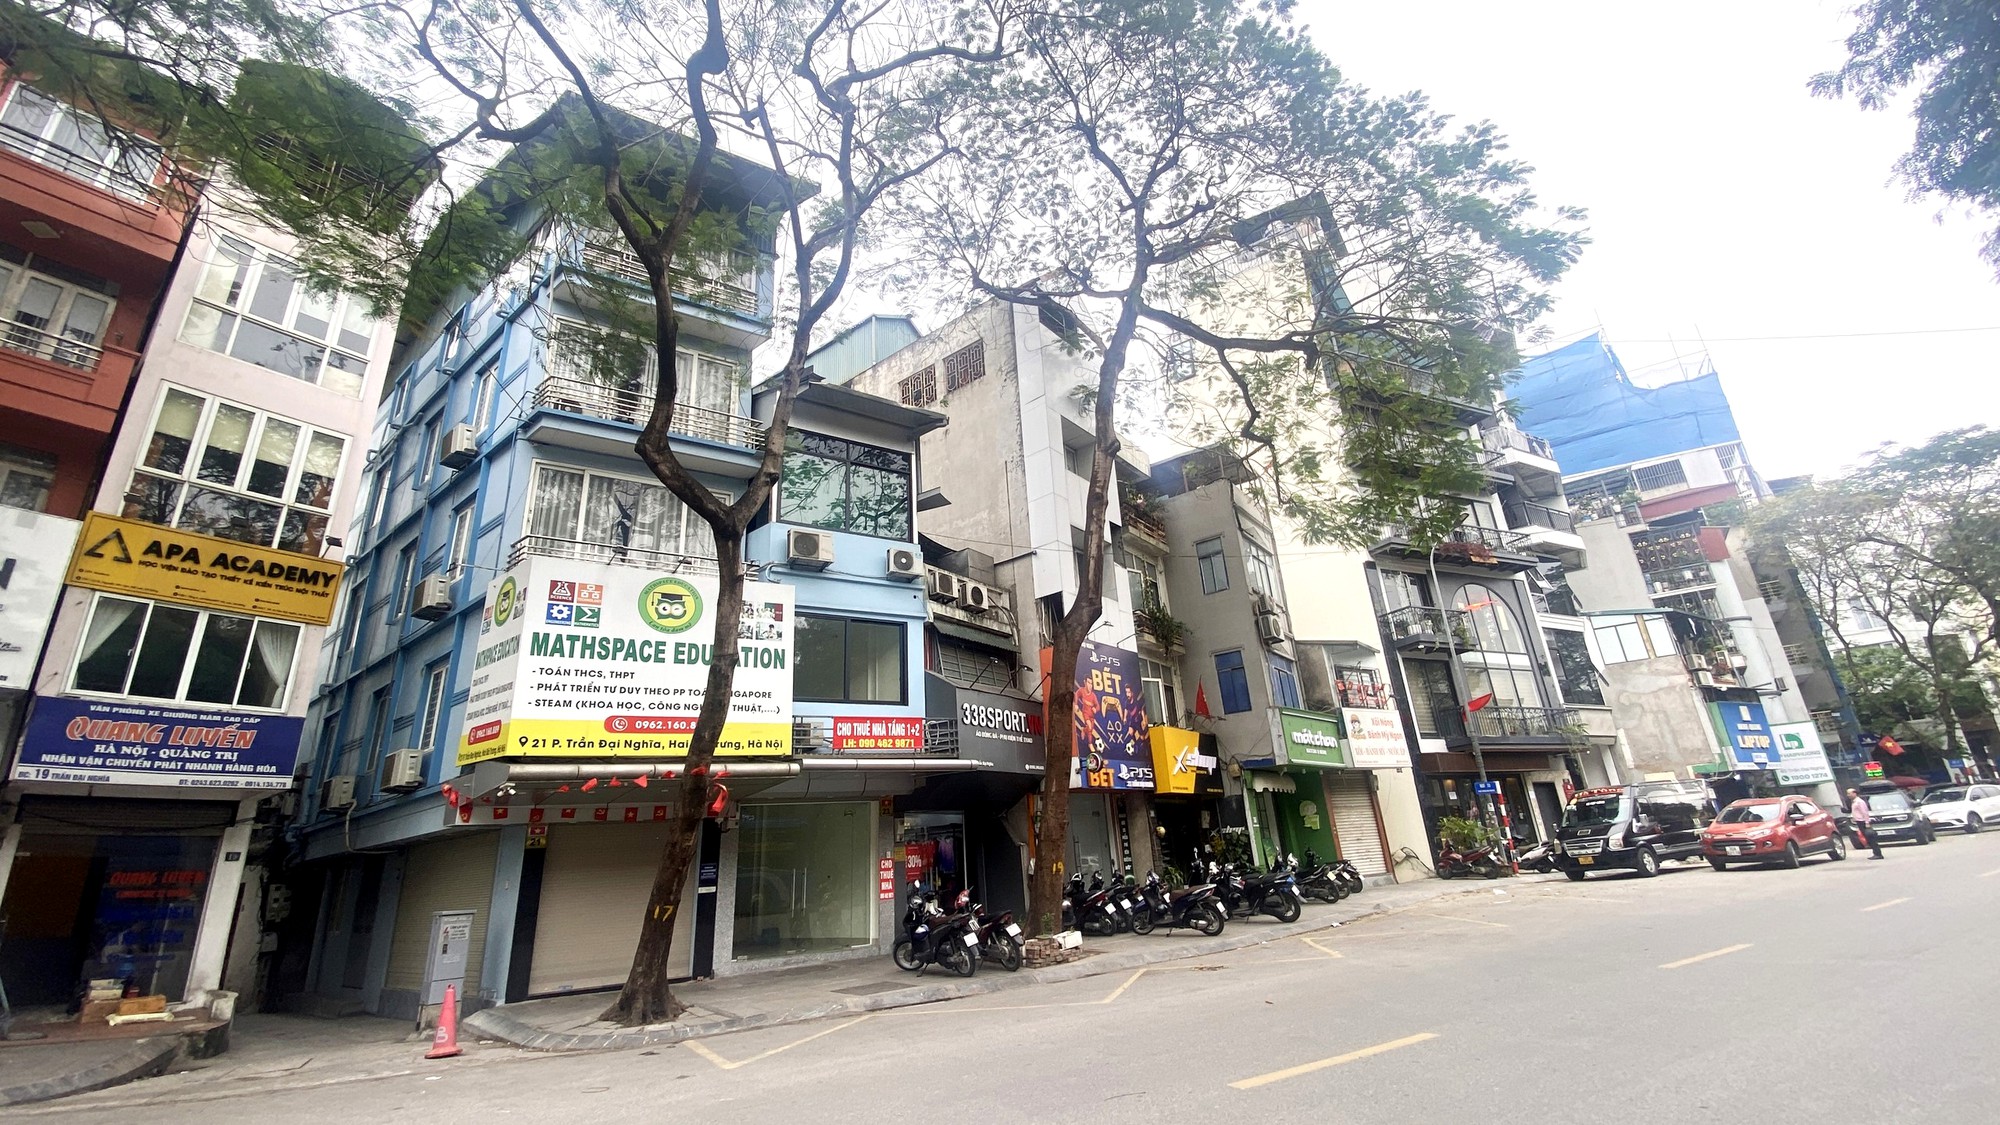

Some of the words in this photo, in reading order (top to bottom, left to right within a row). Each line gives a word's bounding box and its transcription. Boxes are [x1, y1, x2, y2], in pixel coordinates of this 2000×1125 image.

[138, 560, 158, 568] HỌC
[161, 563, 179, 572] VIỆN
[142, 540, 200, 564] APA
[210, 553, 337, 588] ACADEMY
[530, 632, 667, 664] MATHSPACE
[674, 642, 786, 670] EDUTION
[1100, 655, 1120, 667] PS5
[539, 666, 570, 676] TOÁN
[574, 669, 606, 679] THCS,
[610, 671, 636, 679] THPT
[537, 682, 568, 692] PHÁT
[570, 681, 600, 693] TRIỂN
[604, 685, 618, 693] TƯ
[620, 686, 641, 694] DUY
[673, 688, 686, 696] PP
[688, 688, 706, 696] TOÁ
[112, 706, 145, 715] PHÒNG
[535, 699, 572, 707] STEAM
[576, 700, 613, 709] (KHOA
[616, 702, 644, 711] HỌC,
[648, 701, 681, 710] CÔNG
[962, 702, 1042, 736] 338SPORT.VN
[66, 716, 169, 744] QUANG
[168, 724, 257, 749] LUYẾN
[837, 722, 852, 736] CHO
[853, 720, 870, 736] THUÊ
[872, 720, 886, 736] NHÀ
[907, 724, 920, 736] 1+2
[532, 739, 547, 748] 21
[552, 739, 562, 748] P.
[566, 736, 594, 748] Trần
[598, 740, 620, 750] Đại
[624, 739, 665, 750] Nghĩa,
[669, 740, 688, 748] Hai
[715, 740, 744, 750] rưng,
[748, 740, 763, 748] Hà
[765, 740, 783, 750] Nội
[843, 739, 856, 748] LH:
[859, 739, 875, 748] 090
[877, 739, 893, 748] 462
[895, 739, 914, 748] 9871
[1737, 735, 1770, 748] LAPTOP
[94, 743, 116, 754] HÀ
[121, 745, 148, 757] NỘI
[159, 747, 211, 758] QUẢNG
[214, 752, 239, 762] TRỊ
[41, 754, 75, 766] NHẬN
[79, 756, 102, 767] VẬN
[154, 760, 184, 769] PHÁT
[185, 762, 223, 771] NHANH
[225, 762, 254, 772] HÀNG
[256, 763, 276, 773] HÓA
[35, 768, 49, 779] 19
[1130, 767, 1153, 778] PS5
[881, 860, 893, 868] CHO
[908, 855, 922, 868] 30%
[1052, 861, 1064, 875] 19
[880, 869, 894, 879] THUÊ
[881, 880, 893, 890] NHÀ
[654, 905, 673, 921] 17
